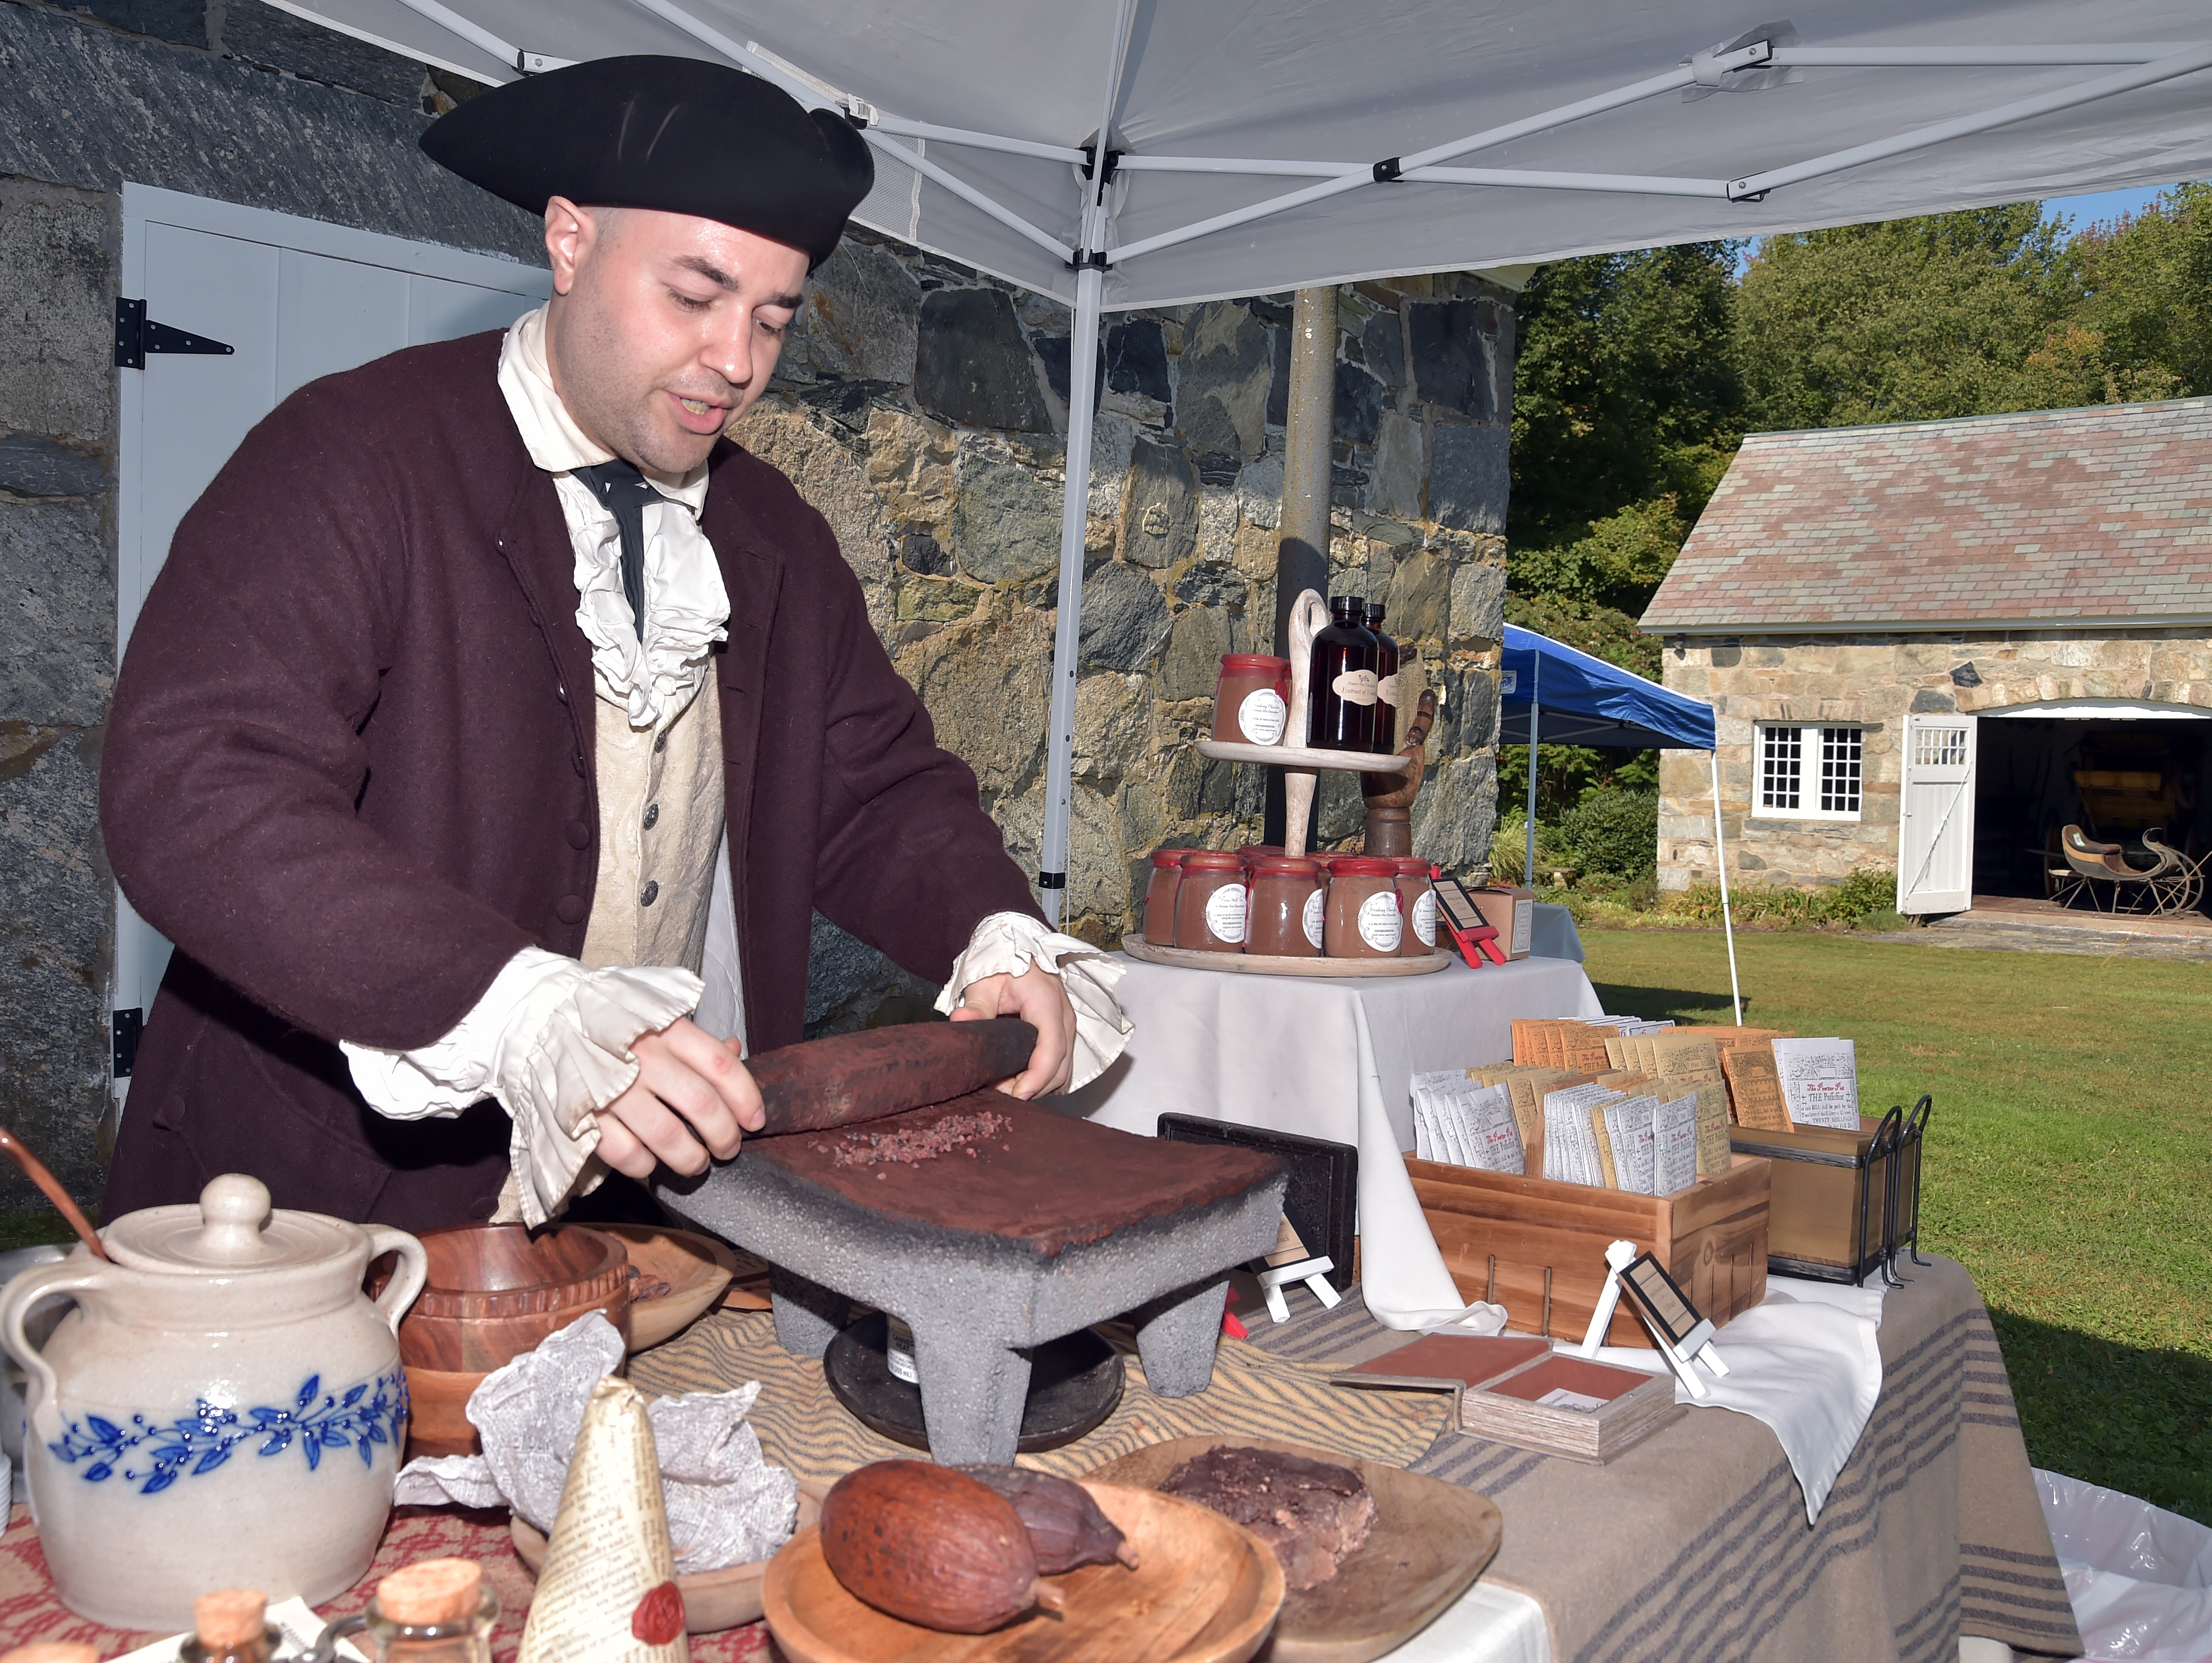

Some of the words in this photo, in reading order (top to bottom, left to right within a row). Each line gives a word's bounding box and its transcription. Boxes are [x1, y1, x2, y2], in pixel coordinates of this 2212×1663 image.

[1584, 1062, 1595, 1072] THE
[1817, 1082, 1834, 1091] Pewter
[1835, 1081, 1844, 1091] Pot
[1809, 1093, 1822, 1102] THE
[1706, 1134, 1714, 1146] THE
[1490, 1144, 1500, 1156] THE
[1672, 1142, 1680, 1156] THE
